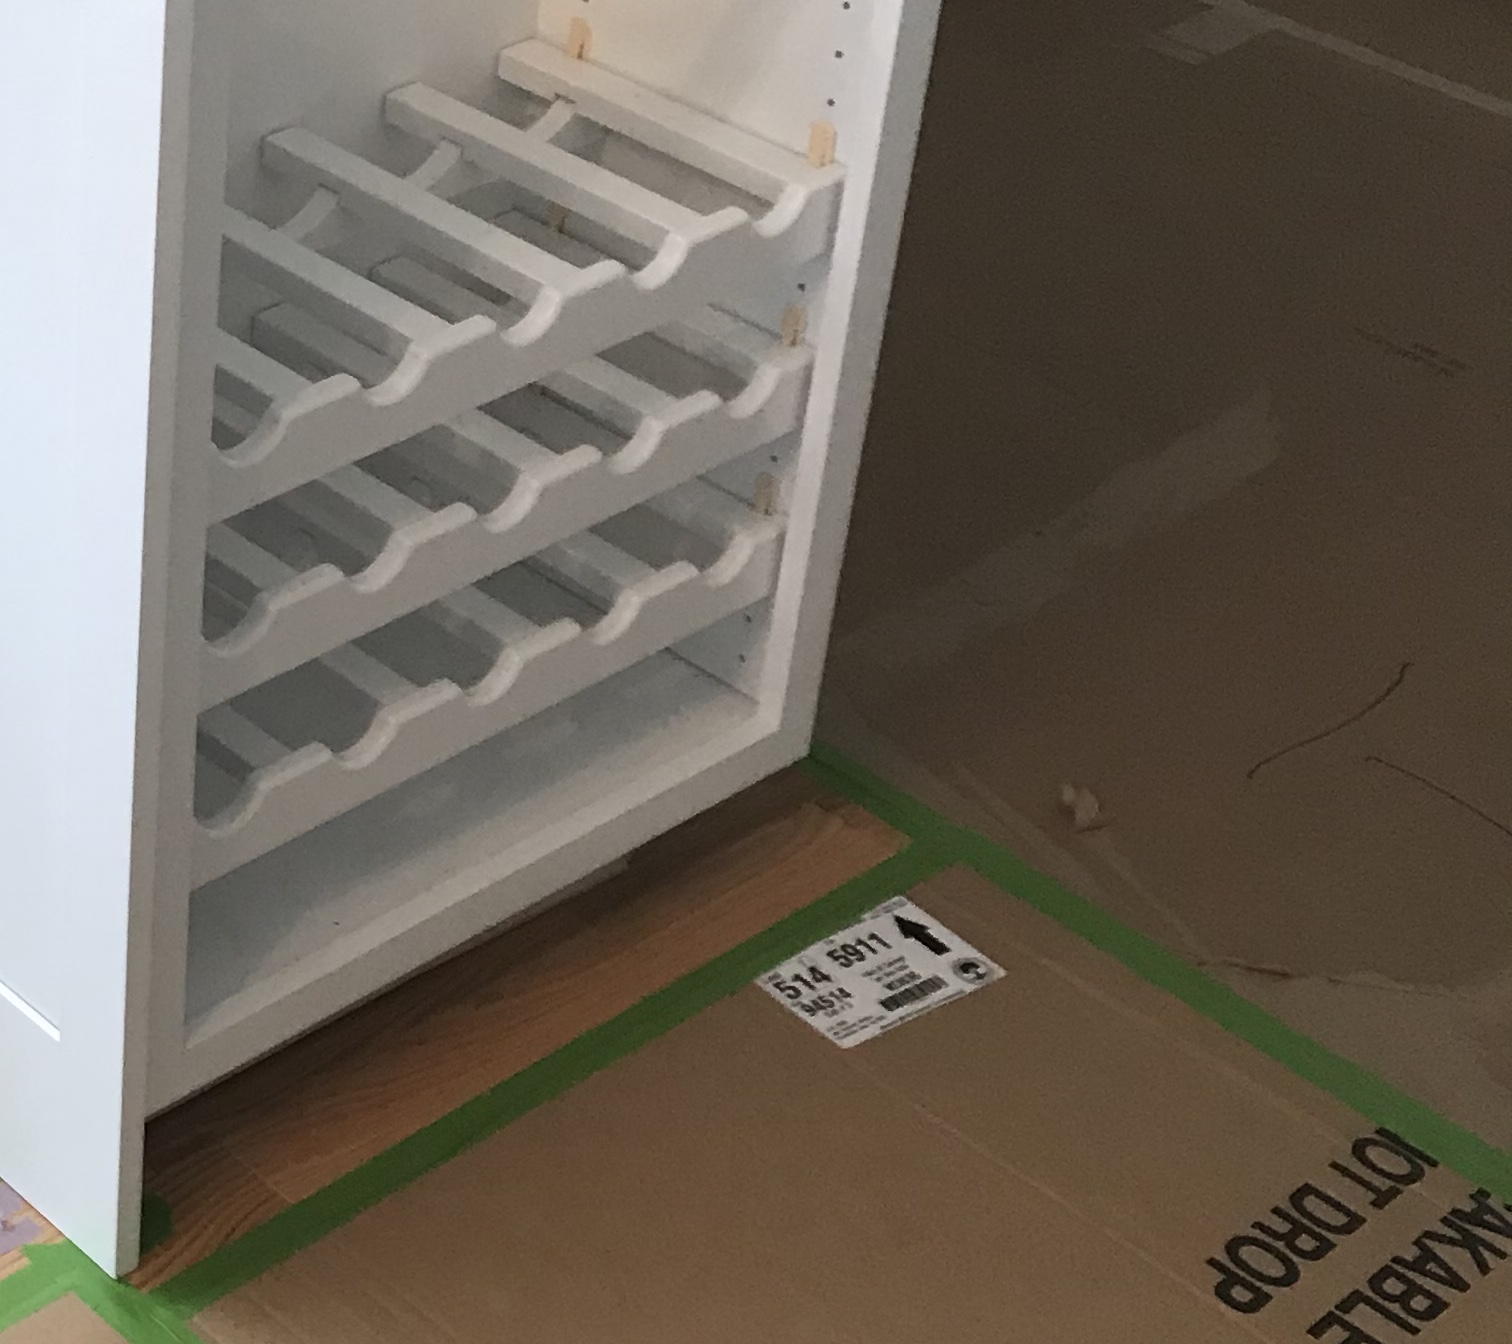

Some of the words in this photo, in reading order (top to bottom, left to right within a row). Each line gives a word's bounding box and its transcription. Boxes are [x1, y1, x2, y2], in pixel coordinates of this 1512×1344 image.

[772, 966, 833, 1000] 514
[826, 932, 893, 969] 5911
[1204, 1183, 1367, 1315] DROP
